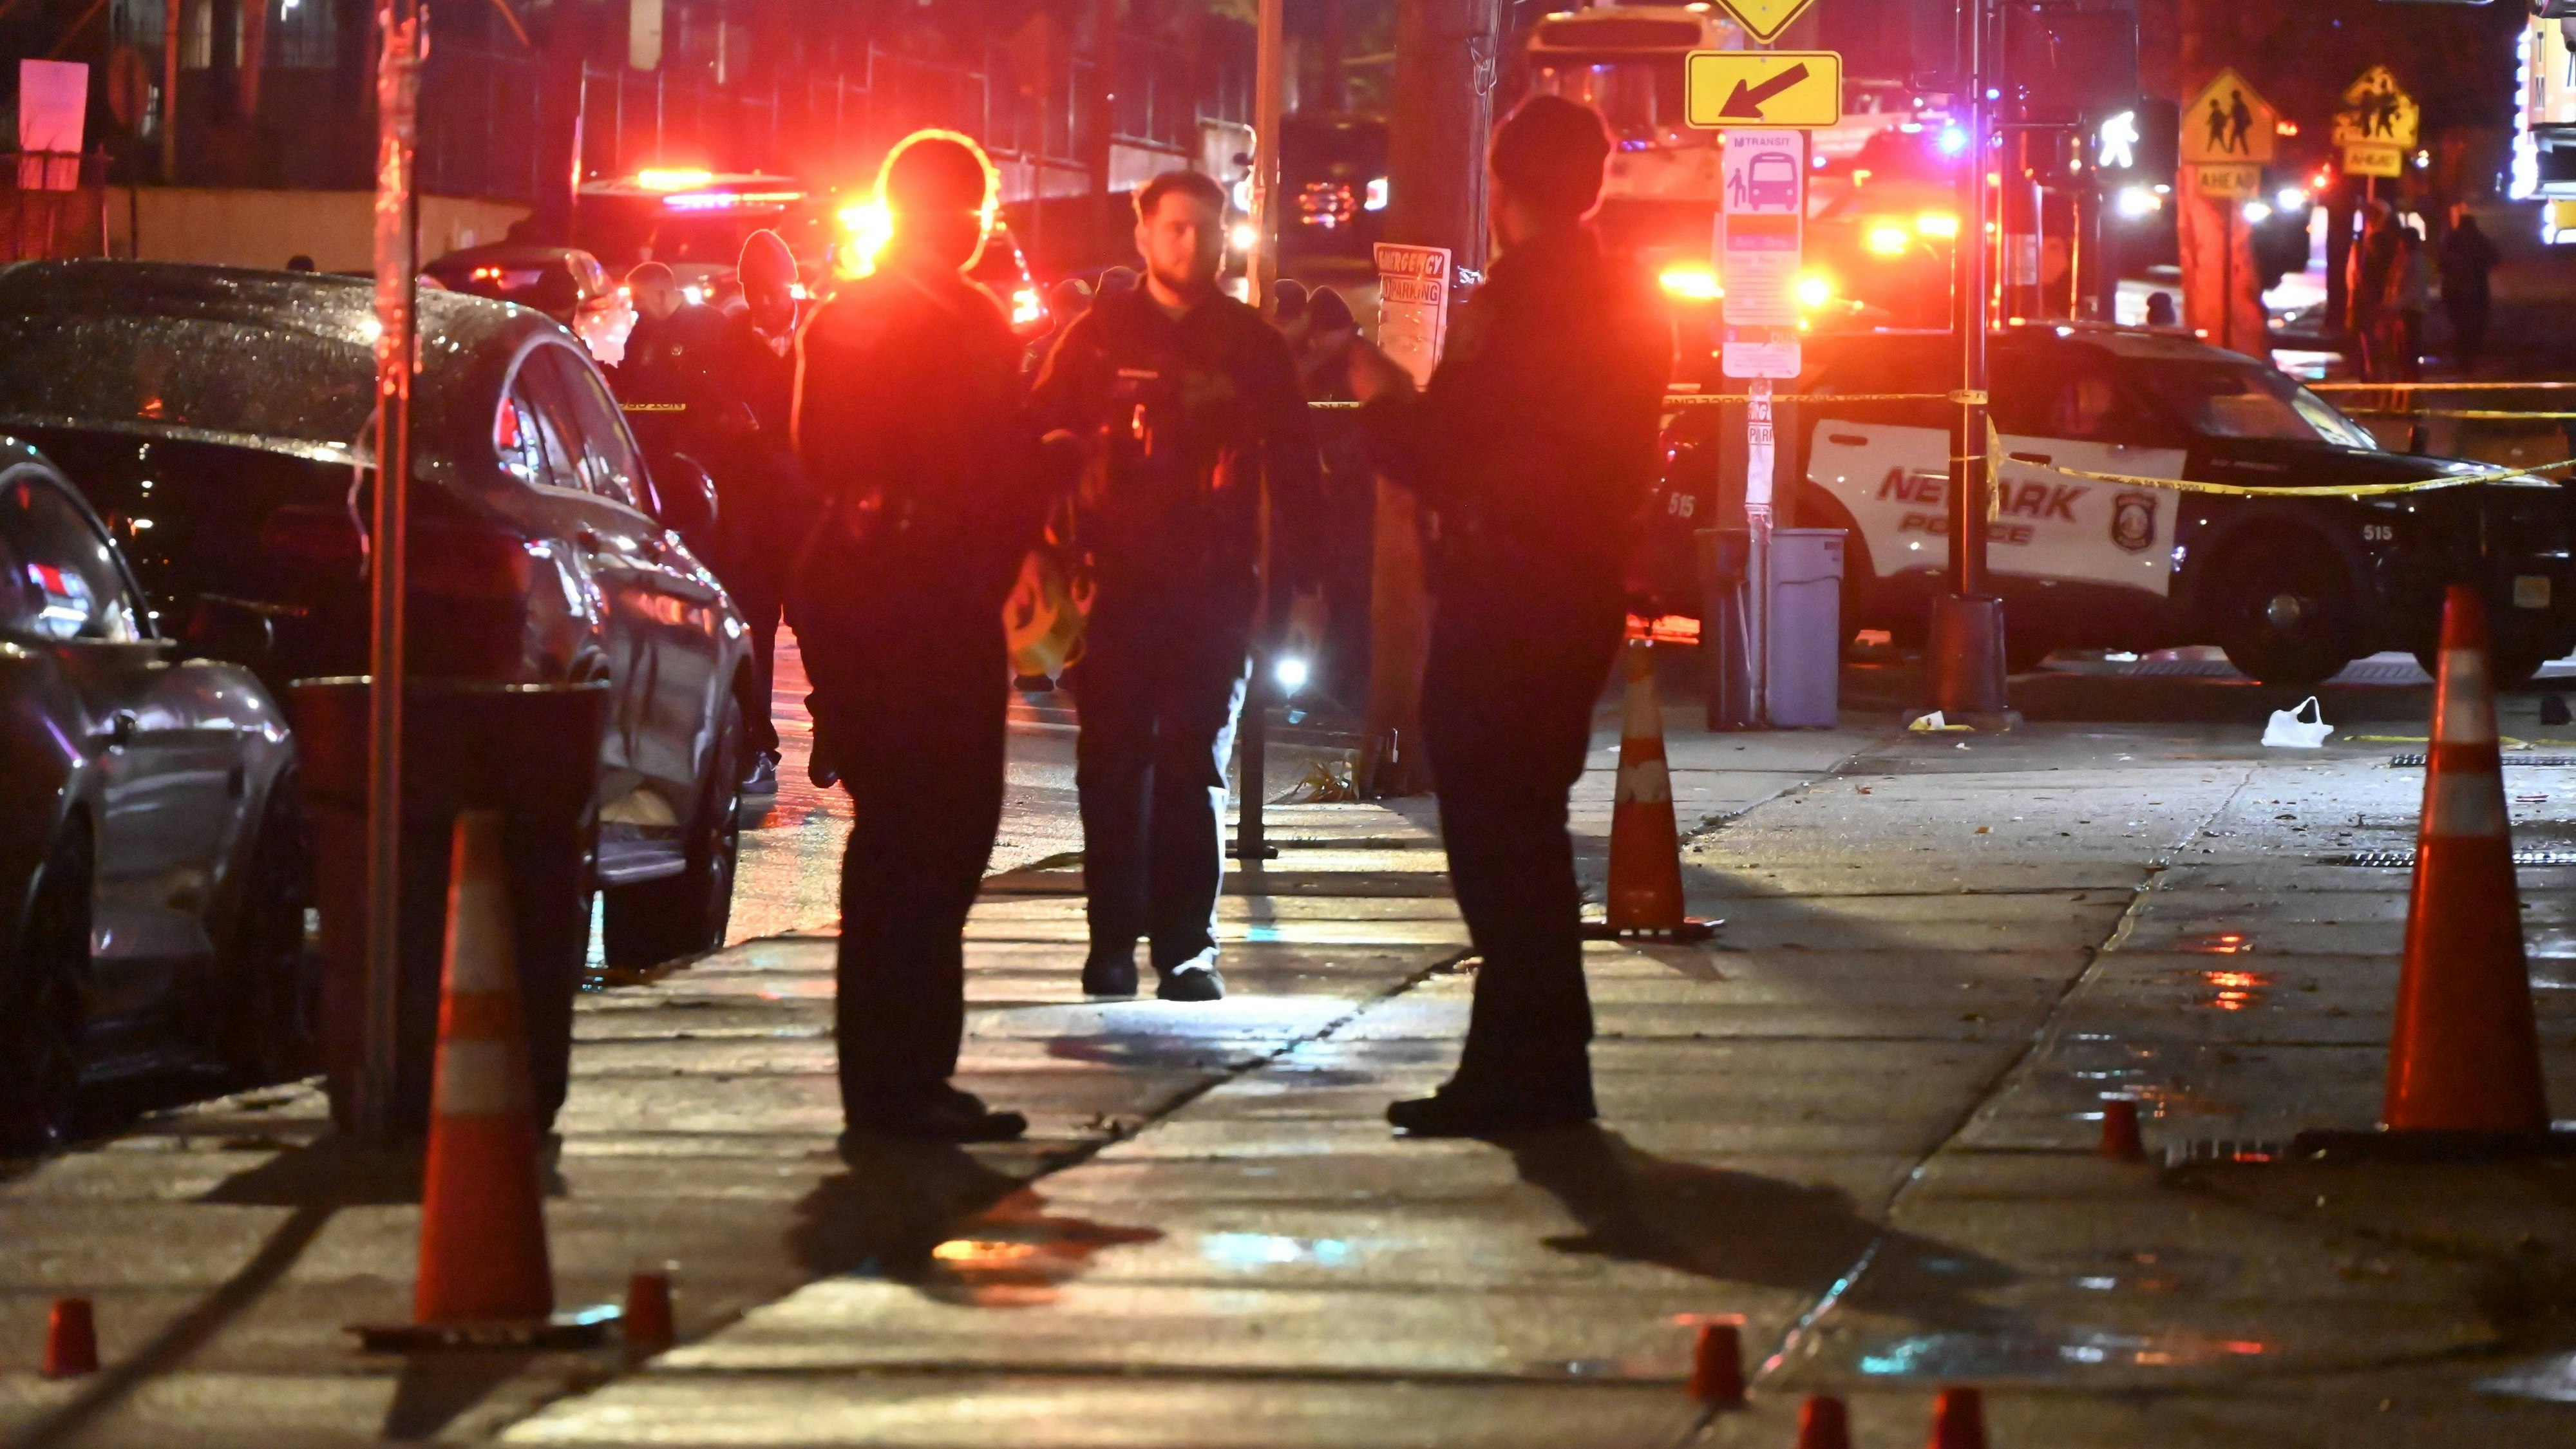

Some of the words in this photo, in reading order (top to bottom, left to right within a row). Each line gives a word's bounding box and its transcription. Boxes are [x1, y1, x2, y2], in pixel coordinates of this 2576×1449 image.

[1745, 137, 1790, 147] TRANSIT
[1391, 281, 1437, 301] PARKING
[1668, 492, 1695, 517] 515
[1875, 466, 2091, 523] NEARK
[1898, 512, 2035, 545] POCE
[2363, 525, 2392, 540] 515
